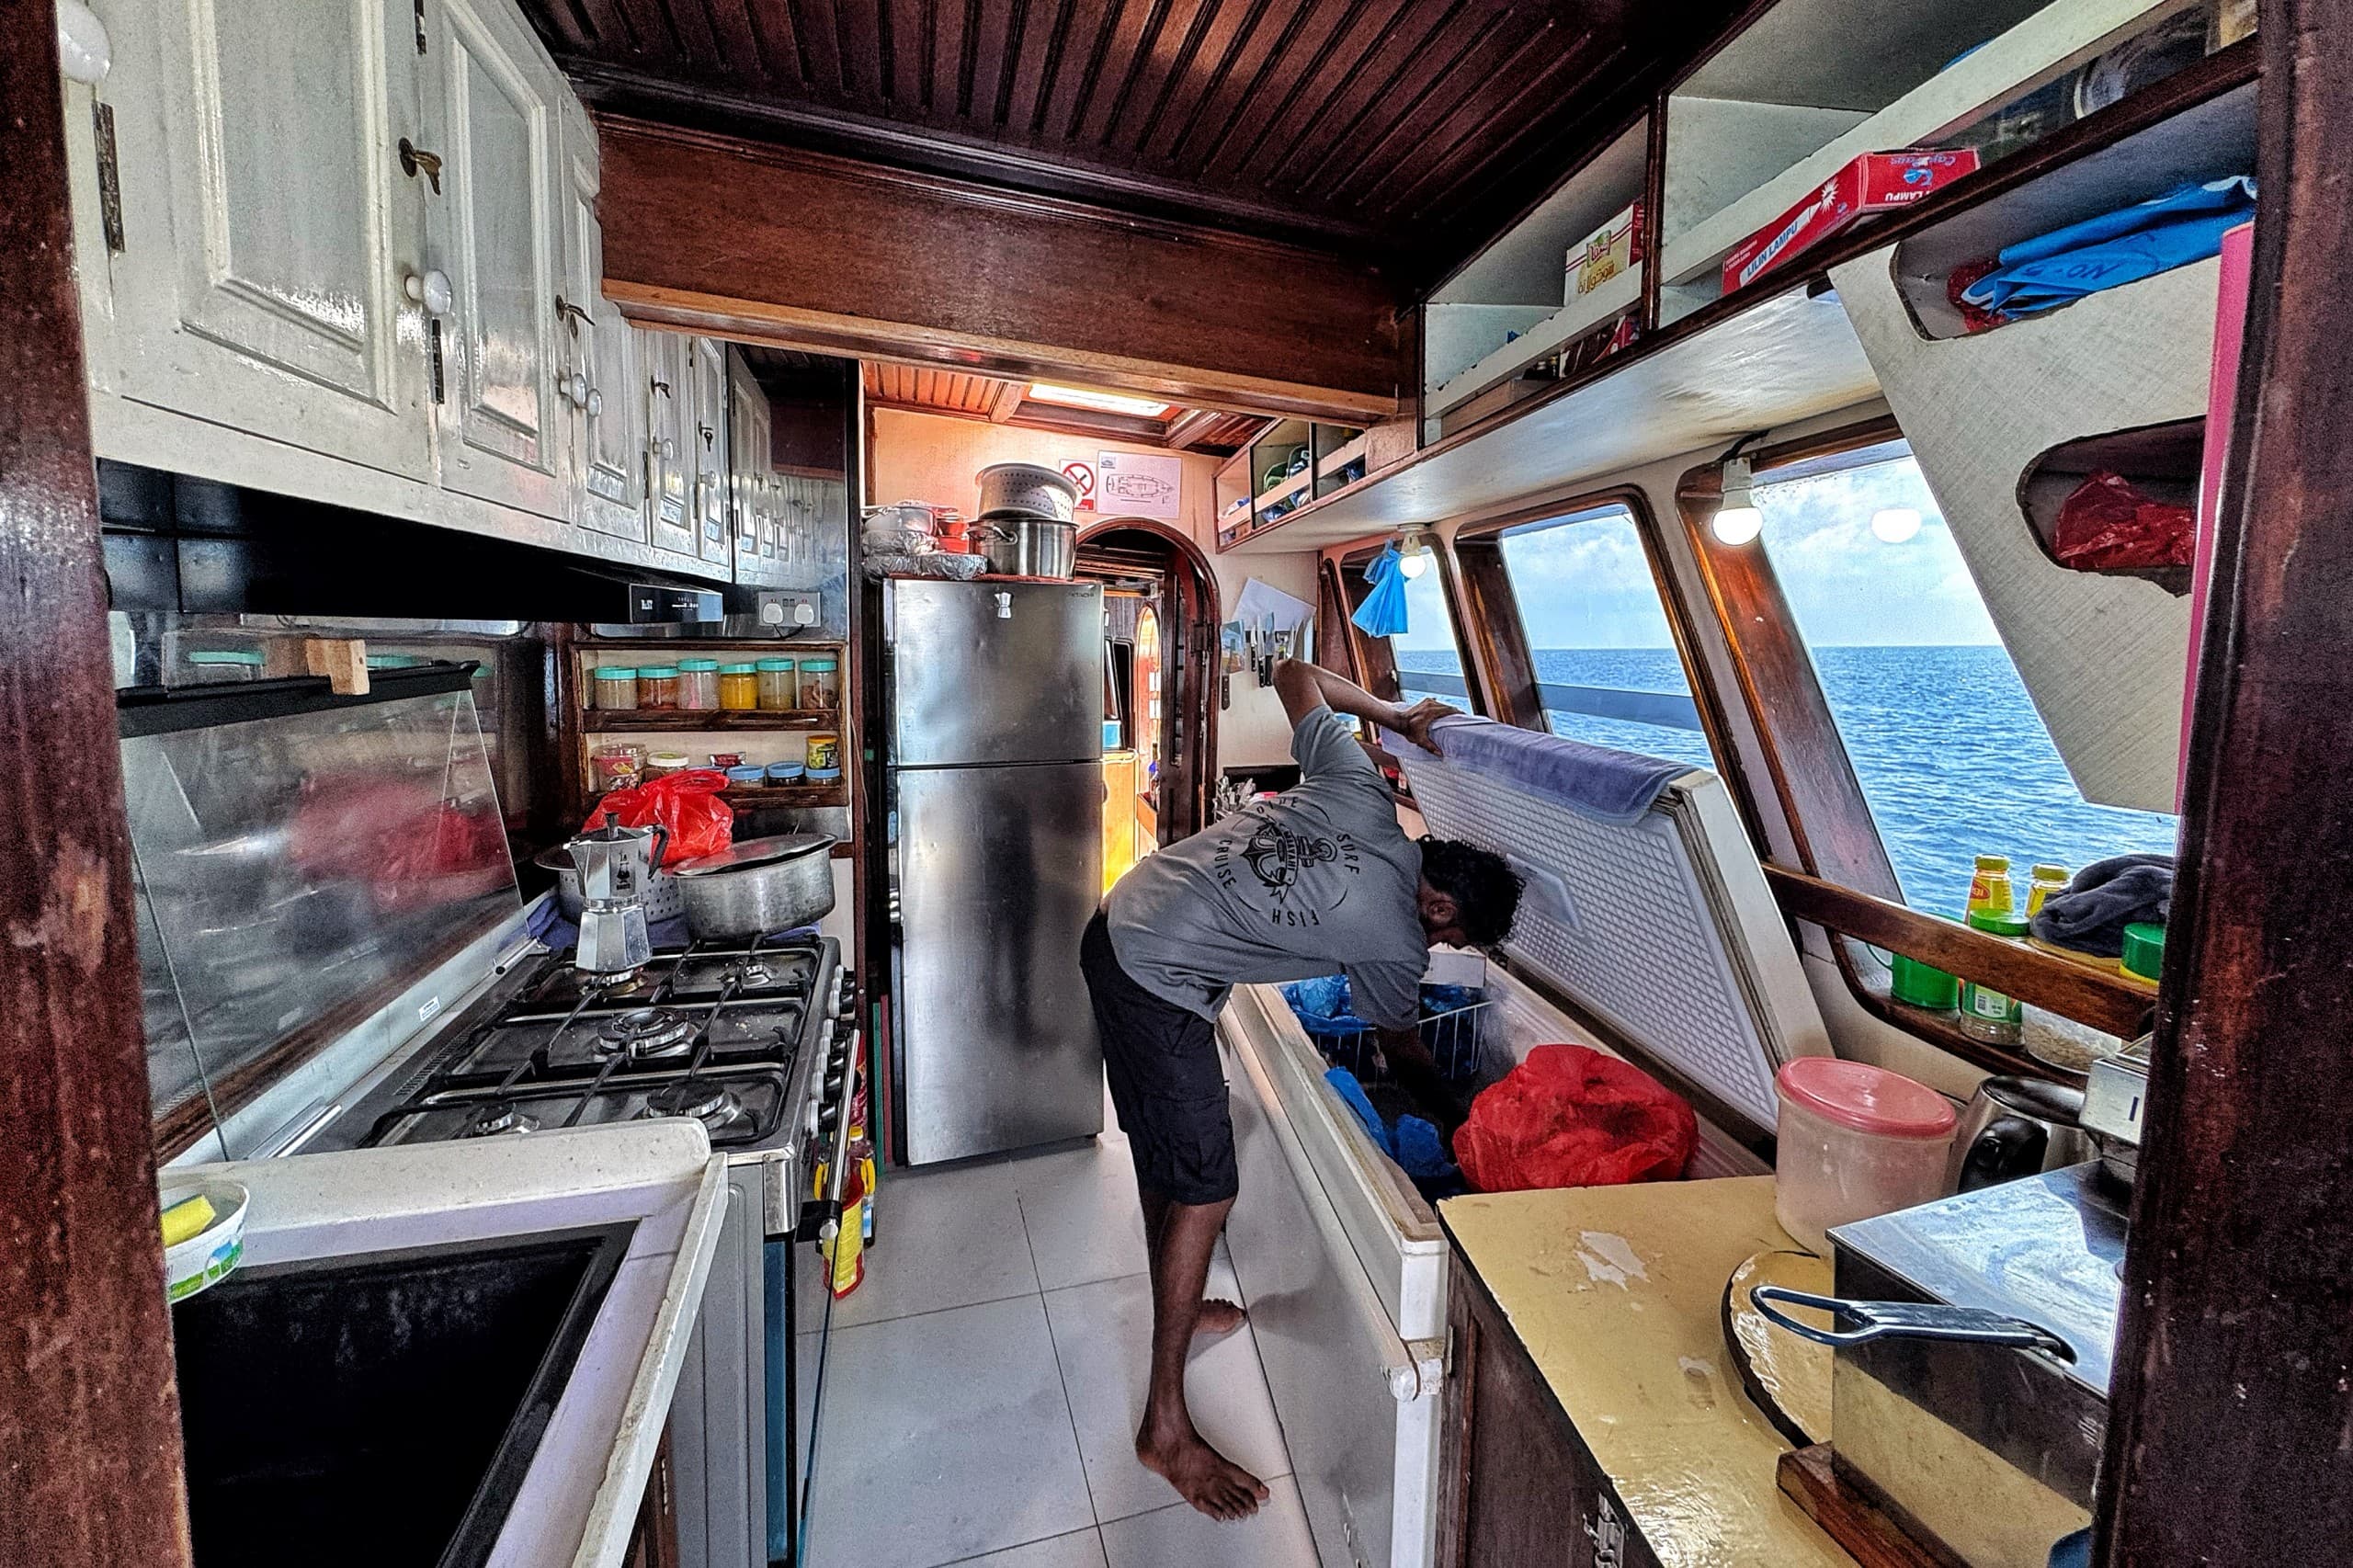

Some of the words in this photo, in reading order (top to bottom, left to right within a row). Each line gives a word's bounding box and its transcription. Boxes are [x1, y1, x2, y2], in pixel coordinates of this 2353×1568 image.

[1929, 154, 1956, 166] Cap
[1885, 191, 1923, 202] LAMPU
[1747, 252, 1768, 277] LILIN
[1768, 222, 1799, 258] LAMPU
[1214, 839, 1237, 890] CRUISE
[1336, 834, 1360, 875] SURF
[1271, 908, 1321, 927] FISH
